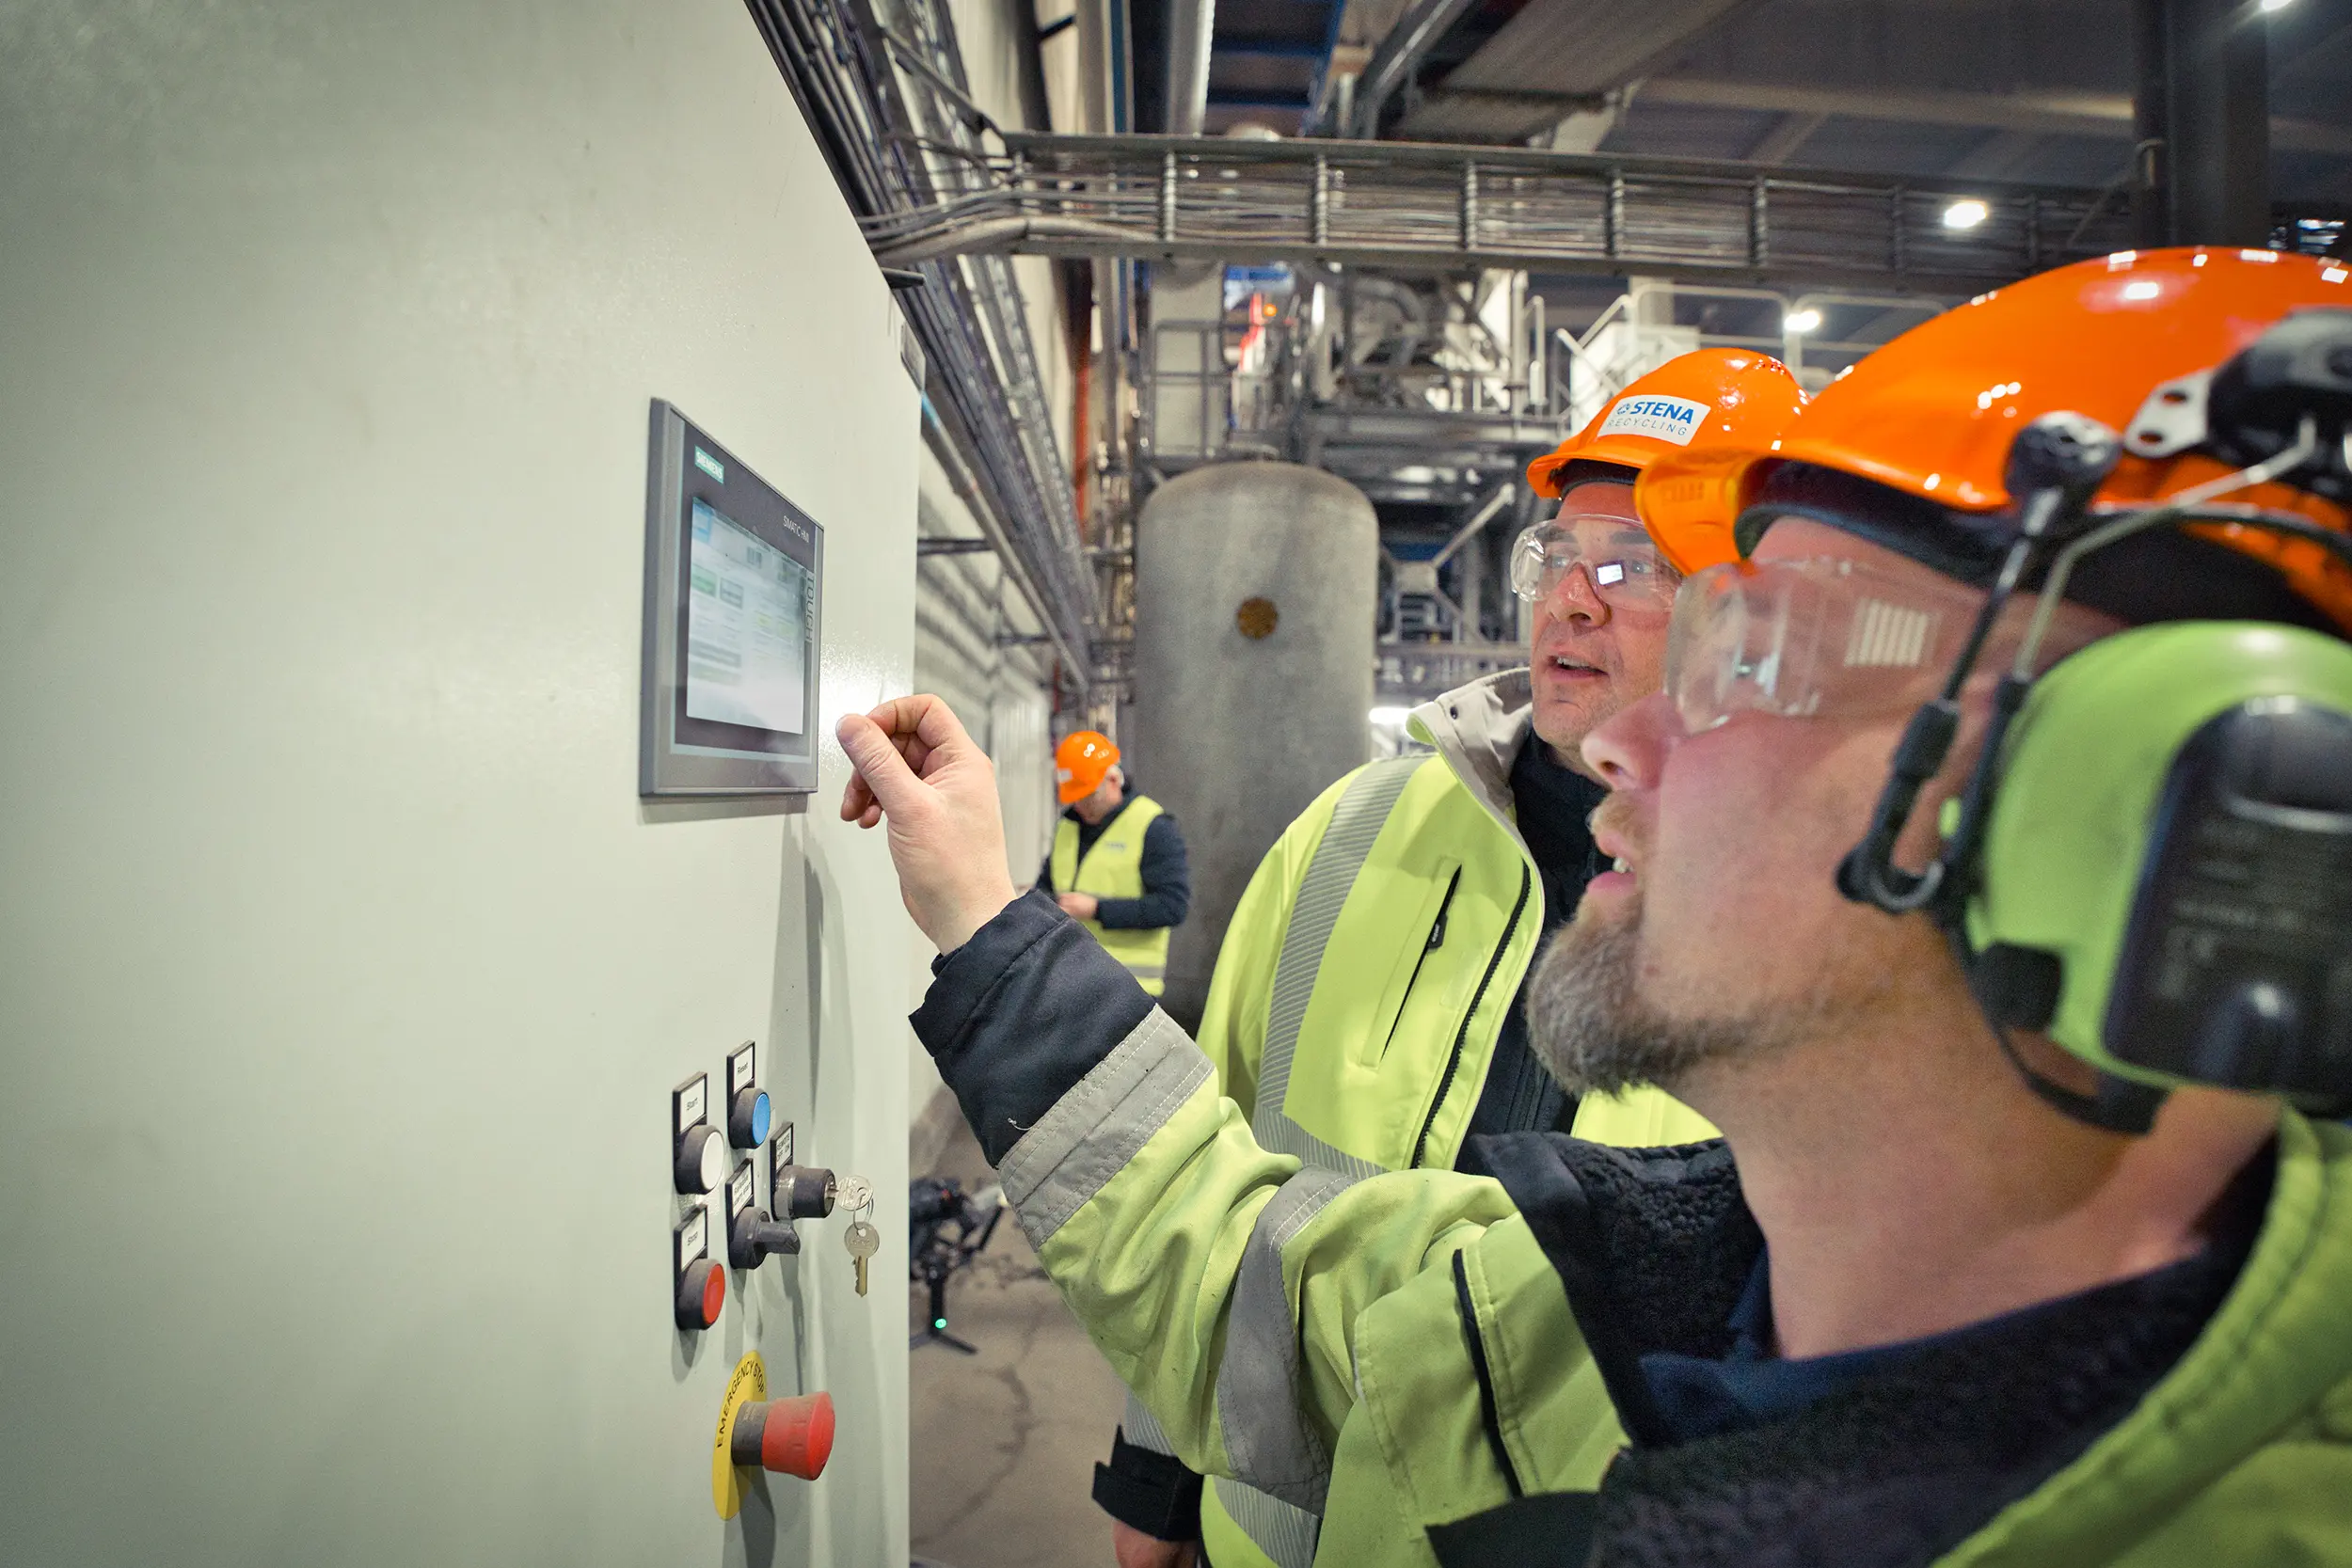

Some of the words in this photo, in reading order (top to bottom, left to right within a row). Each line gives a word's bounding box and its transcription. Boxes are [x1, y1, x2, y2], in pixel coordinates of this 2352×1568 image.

[1607, 418, 1687, 436] RECYCLING
[1629, 402, 1694, 424] STENA
[696, 451, 723, 481] SIEMENS
[805, 577, 815, 641] TOUCH
[717, 1360, 755, 1448] EMERGENCY
[753, 1363, 765, 1394] STOP
